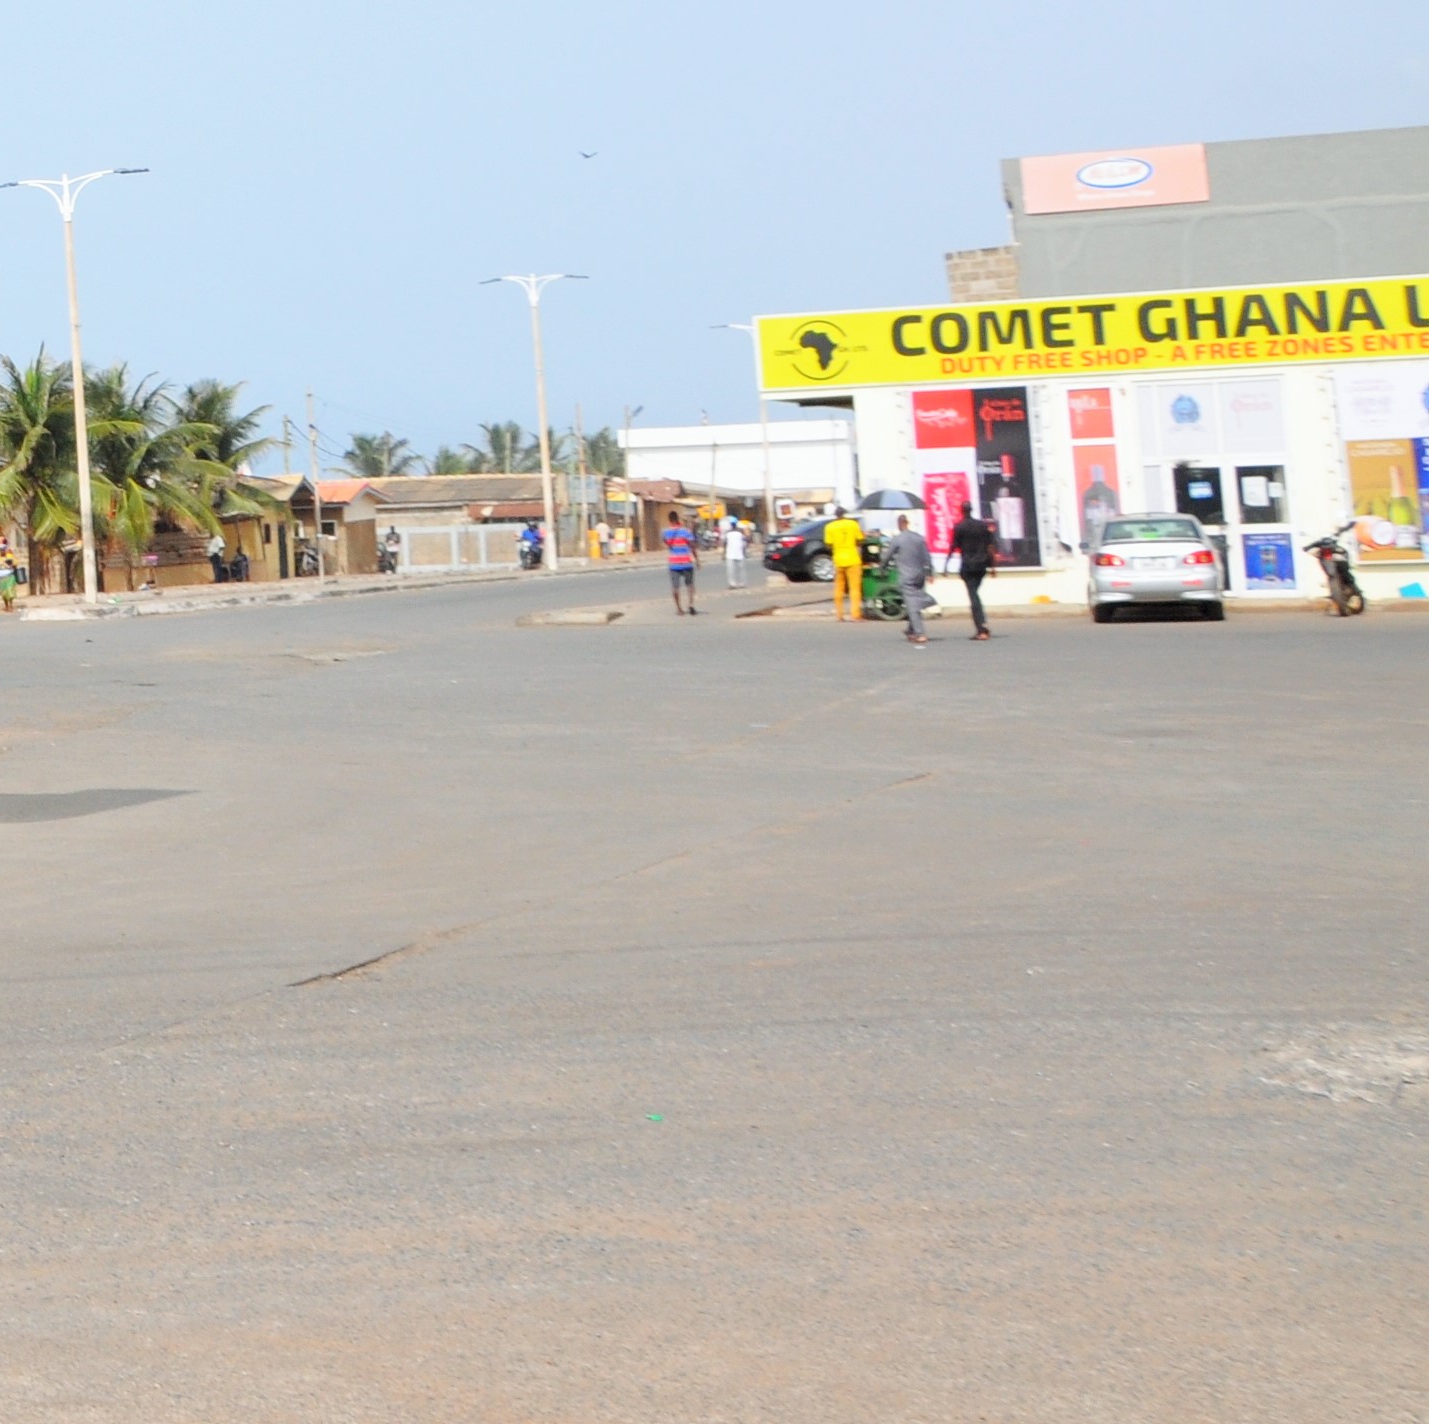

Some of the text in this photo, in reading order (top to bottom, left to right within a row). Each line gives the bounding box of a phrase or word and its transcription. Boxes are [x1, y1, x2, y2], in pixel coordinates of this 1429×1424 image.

[891, 303, 1116, 356] COMET
[1137, 287, 1385, 343] GHANA
[942, 353, 1006, 374] DUTY
[1013, 351, 1075, 370] FREE
[1081, 347, 1148, 367] SHOP
[1171, 345, 1187, 361] A
[1195, 341, 1259, 360] FREE
[1267, 336, 1354, 357] ZONES
[1363, 332, 1429, 352] ENTE
